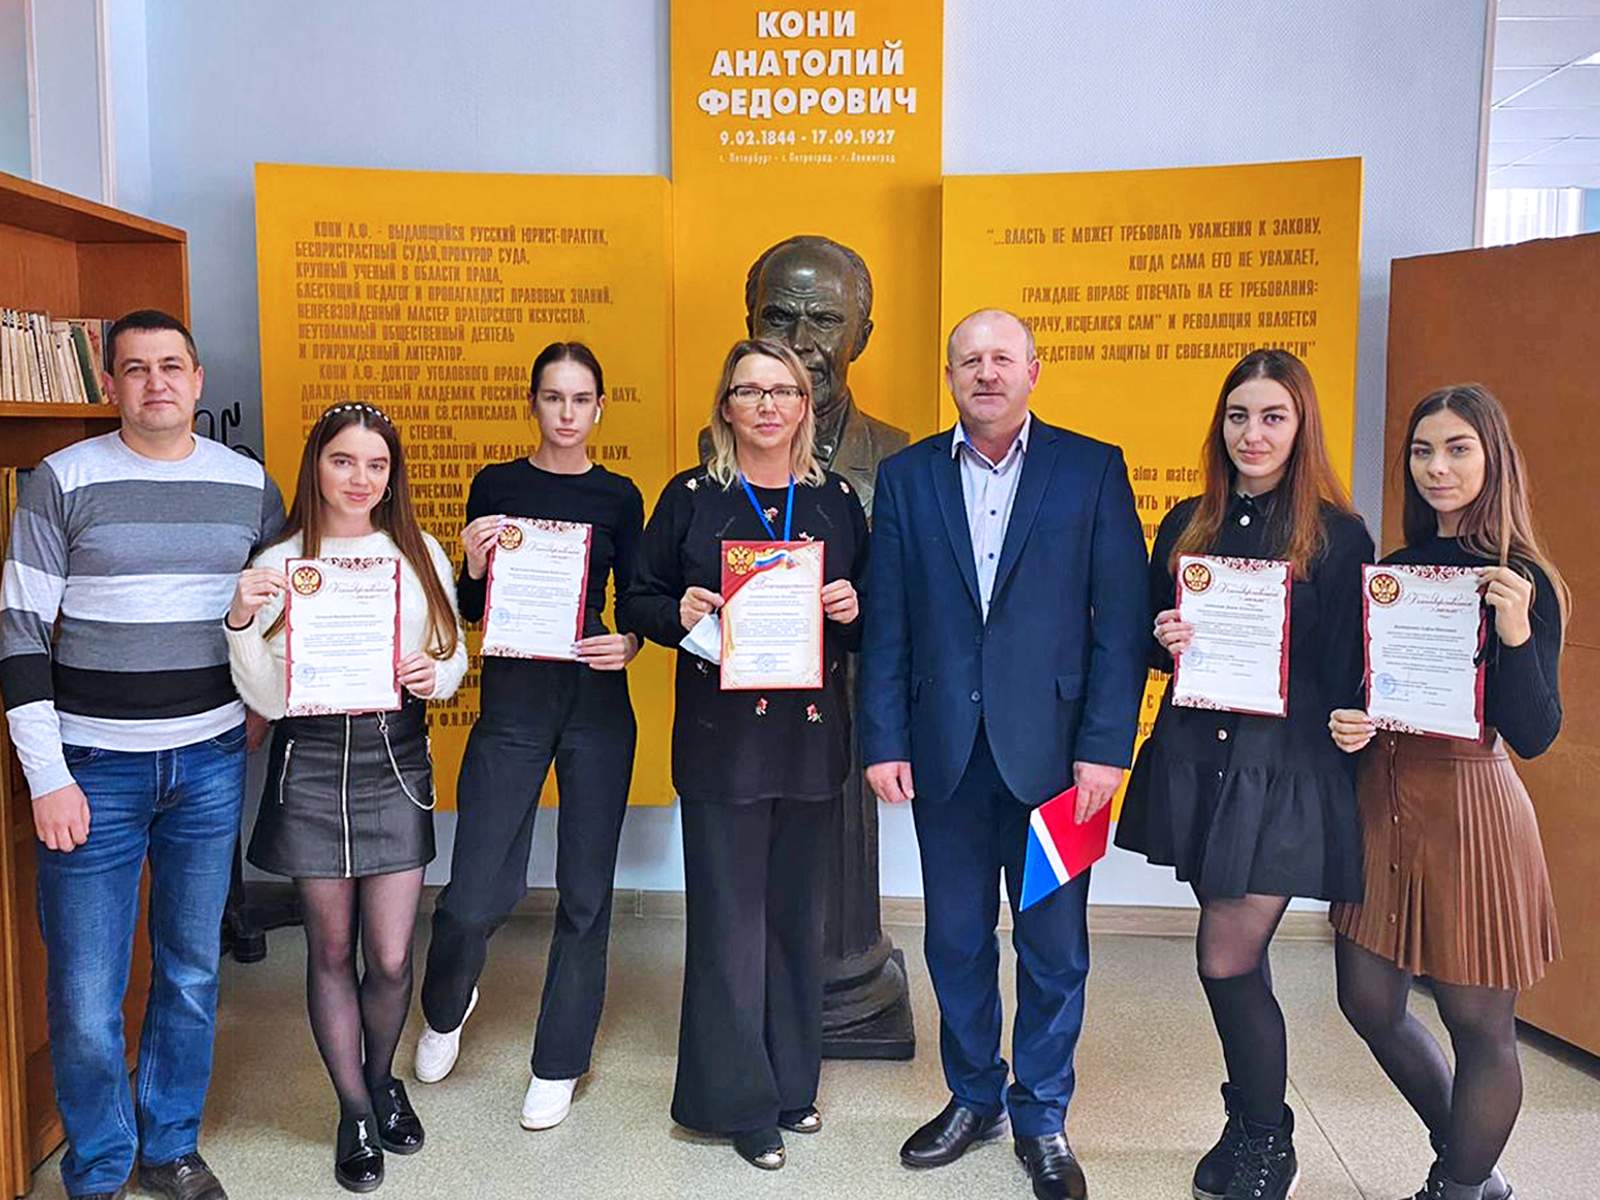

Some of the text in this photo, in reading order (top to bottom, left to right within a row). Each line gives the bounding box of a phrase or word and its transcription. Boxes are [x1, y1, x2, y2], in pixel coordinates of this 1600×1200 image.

[757, 10, 856, 38] КОНИ
[710, 39, 905, 77] АНАТОЛИЙ
[698, 87, 918, 119] ФЕДОРОВИЧ
[719, 130, 796, 146] 9.02.1844
[811, 129, 896, 146] 17.09.1927
[314, 221, 342, 237] КОНИ
[348, 223, 372, 239] А.Ф.
[388, 223, 465, 242] ВЫДАЮЩИЙСЯ
[471, 225, 516, 242] РУССКИЙ
[1052, 227, 1066, 244] НЕ
[1072, 225, 1114, 243] МОЖЕТ
[1120, 223, 1182, 242] ТРЕБОВАТЬ
[1188, 219, 1252, 239] УВАЖЕНИЯ
[1258, 219, 1267, 236] К
[295, 241, 397, 260] БЕСПРИСТРАСТНЫЙ
[296, 261, 347, 278] КРУПНЫЙ
[354, 263, 396, 280] УЧЕНЫЙ
[402, 265, 409, 280] В
[415, 266, 460, 282] ОБЛАСТИ
[1129, 253, 1164, 273] КОГДА
[1171, 252, 1206, 270] САМА
[1211, 251, 1232, 268] ЕГО
[1238, 250, 1252, 267] НЕ
[296, 281, 360, 300] БЛЕСТЯЩИЙ
[367, 285, 409, 302] ПЕДАГОГ
[415, 286, 422, 300] И
[428, 286, 505, 304] ПРОПАГАНДИСТ
[511, 288, 565, 303] ПРАВОВЫХ
[1022, 286, 1081, 304] ГРАЖДАНЕ
[1086, 285, 1129, 301] ВПРАВЕ
[1135, 283, 1191, 300] ОТВЕЧАТЬ
[1198, 282, 1213, 298] НА
[1219, 282, 1233, 298] ЕЕ
[408, 306, 449, 321] МАСТЕР
[455, 307, 523, 323] ОРАТОРСКОГО
[1168, 313, 1176, 330] И
[1182, 312, 1251, 330] РЕВОЛЮЦИЯ
[1258, 310, 1317, 328] ЯВЛЯЕТСЯ
[298, 321, 515, 343] НЕУТОМИМЫЙ ОБЩЕСТВЕННЫЙ ДЕЯТЕЛЬ
[299, 343, 306, 359] И
[312, 343, 400, 362] ПРИРОЖДЕННЫЙ
[1036, 345, 1095, 363] РЕДСТВОМ
[1101, 344, 1150, 363] ЗАЩИТЫ
[1156, 344, 1169, 361] ОТ
[319, 365, 347, 381] КОНИ
[428, 366, 489, 381] УГОЛОВНОГО
[301, 384, 350, 402] ДВАЖДЫ
[355, 384, 412, 400] ПОЧЕТНЫЙ
[417, 386, 475, 402] АКАДЕМИК
[440, 463, 460, 478] КАК
[1132, 466, 1200, 482] alma mater
[409, 483, 463, 499] ТИЧЕСКОМ
